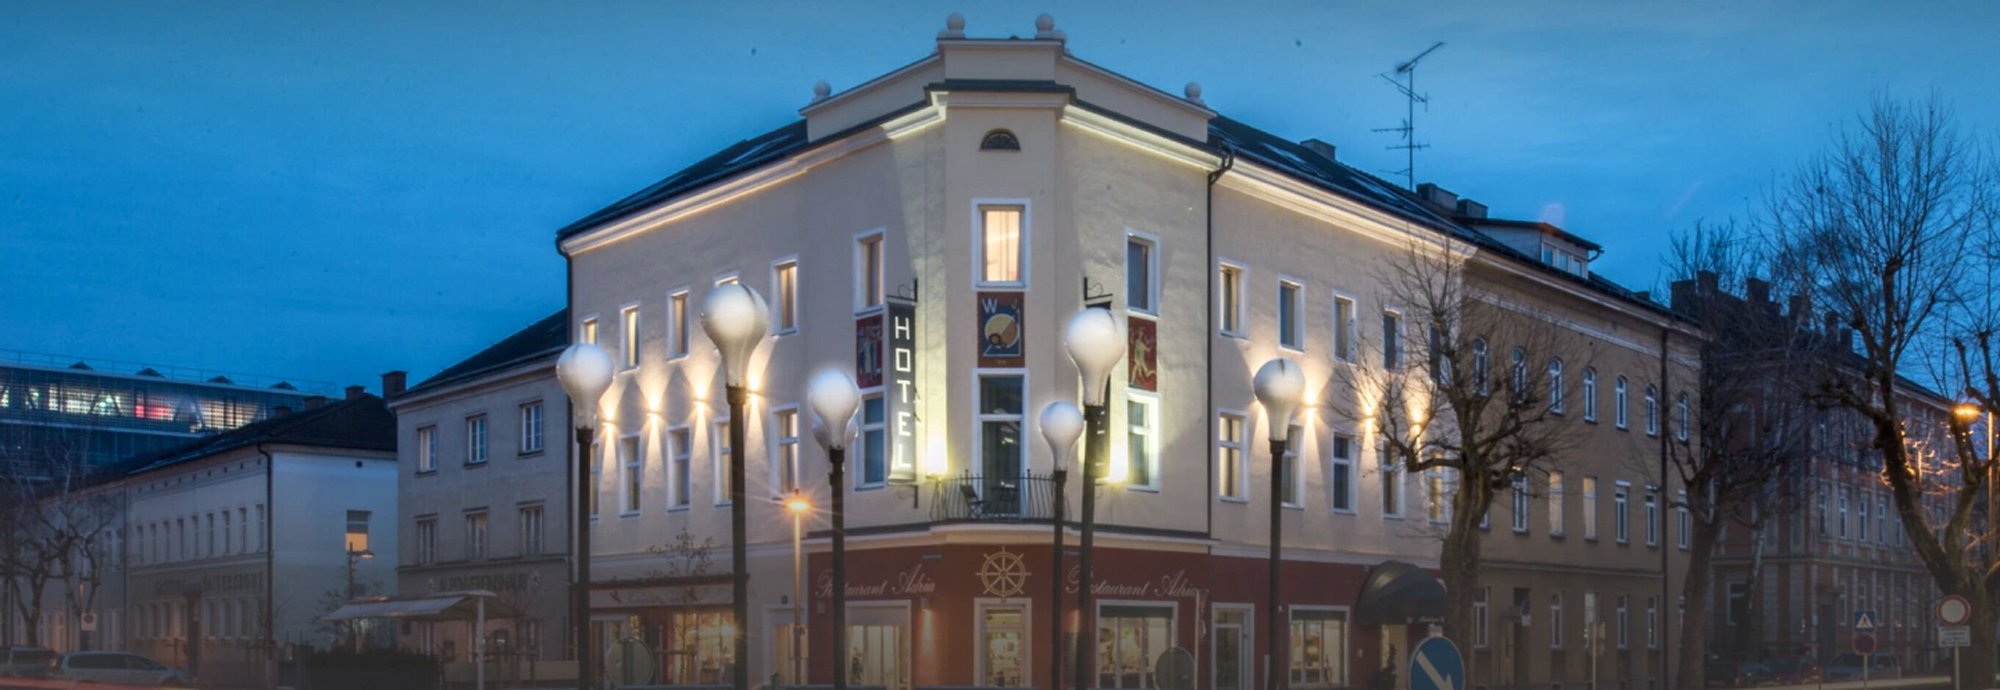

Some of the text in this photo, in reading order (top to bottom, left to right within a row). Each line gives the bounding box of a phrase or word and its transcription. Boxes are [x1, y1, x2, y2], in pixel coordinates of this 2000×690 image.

[981, 298, 998, 314] W
[894, 315, 912, 469] HOTEL
[814, 563, 936, 598] Rtaurant Adria
[1065, 563, 1150, 597] Rstaurant
